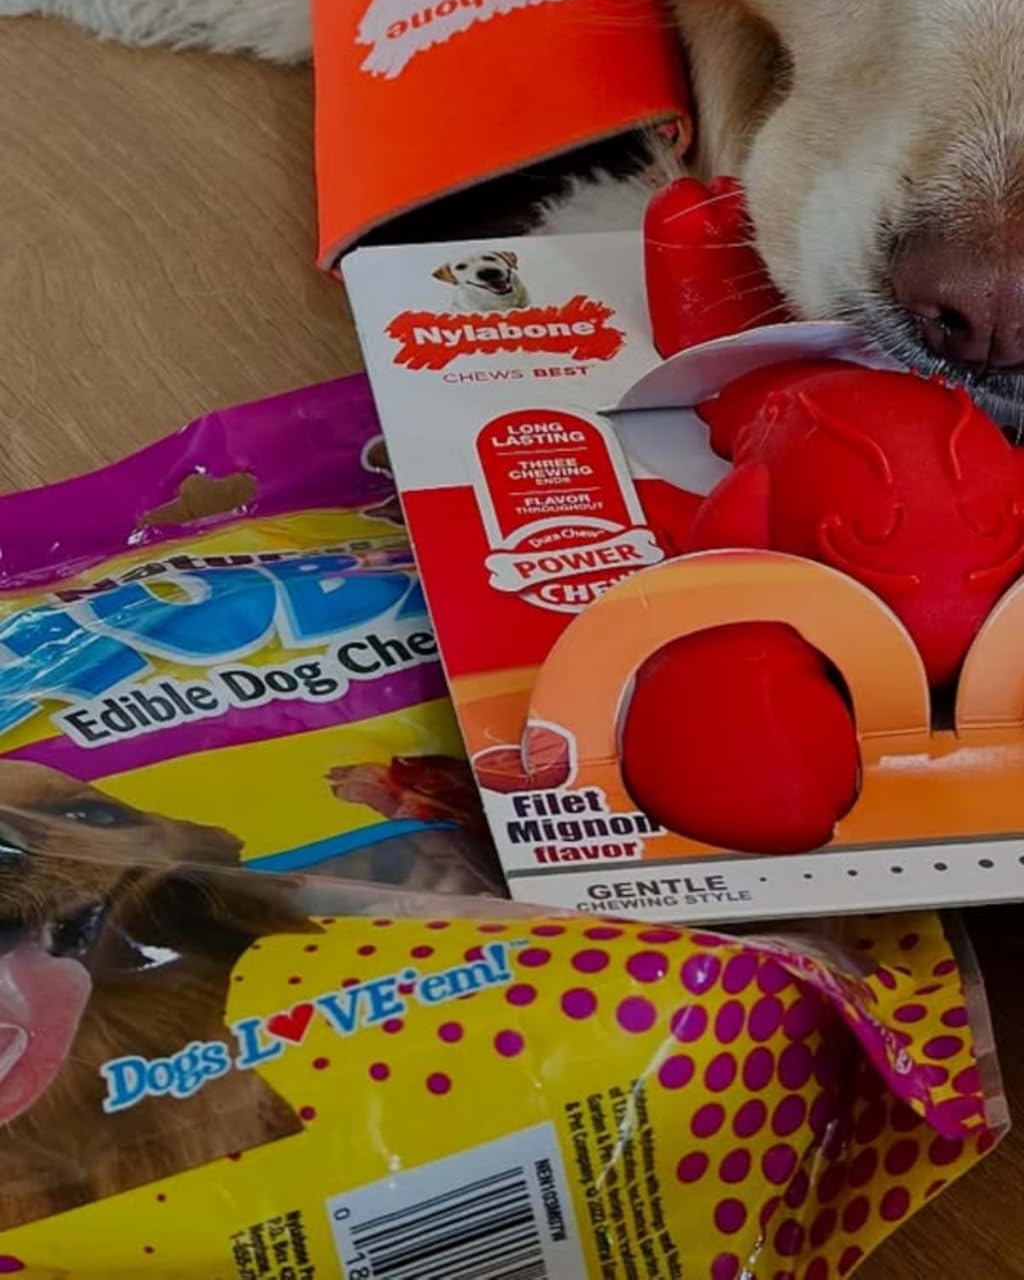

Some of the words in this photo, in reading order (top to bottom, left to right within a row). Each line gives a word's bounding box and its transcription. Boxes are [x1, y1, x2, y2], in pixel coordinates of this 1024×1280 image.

[412, 320, 597, 347] Nylabone
[443, 369, 524, 384] CHEWS
[533, 365, 591, 379] BEST
[492, 431, 586, 447] LASTING
[507, 422, 564, 435] LONG
[508, 466, 593, 480] CHEWING
[518, 458, 578, 470] THREE
[515, 502, 603, 515] THROUGHOUT
[524, 494, 591, 507] FLAVOR
[513, 544, 644, 579] POWER
[62, 681, 219, 742] Edible
[220, 663, 339, 703] Dog
[337, 629, 438, 674] Che
[512, 790, 604, 818] Filet
[534, 841, 638, 863] flavor
[587, 875, 728, 900] GENTLE
[576, 894, 679, 913] CHEWING
[685, 890, 753, 906] STYLE
[105, 1042, 230, 1110] Dogs
